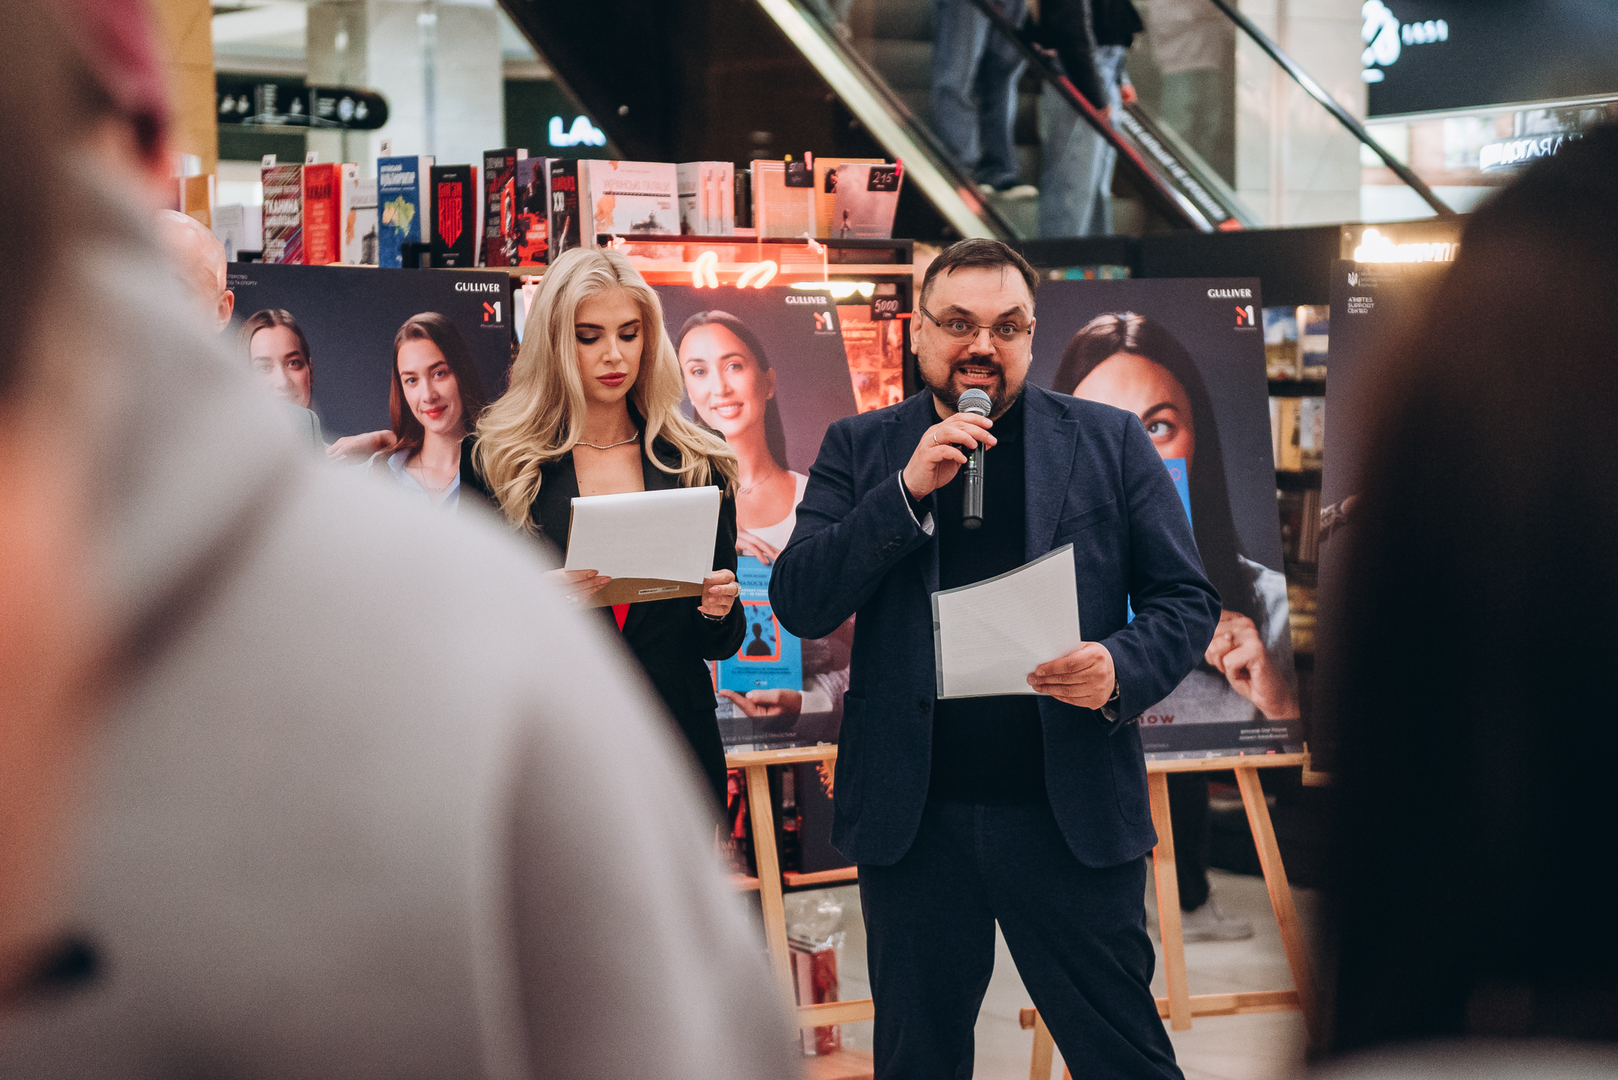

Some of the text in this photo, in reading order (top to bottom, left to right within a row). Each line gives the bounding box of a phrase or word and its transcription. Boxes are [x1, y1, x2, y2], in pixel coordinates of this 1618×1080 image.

[455, 282, 500, 292] GULLIVER
[1207, 288, 1252, 298] GULLIVER
[785, 295, 828, 304] GULLIVER
